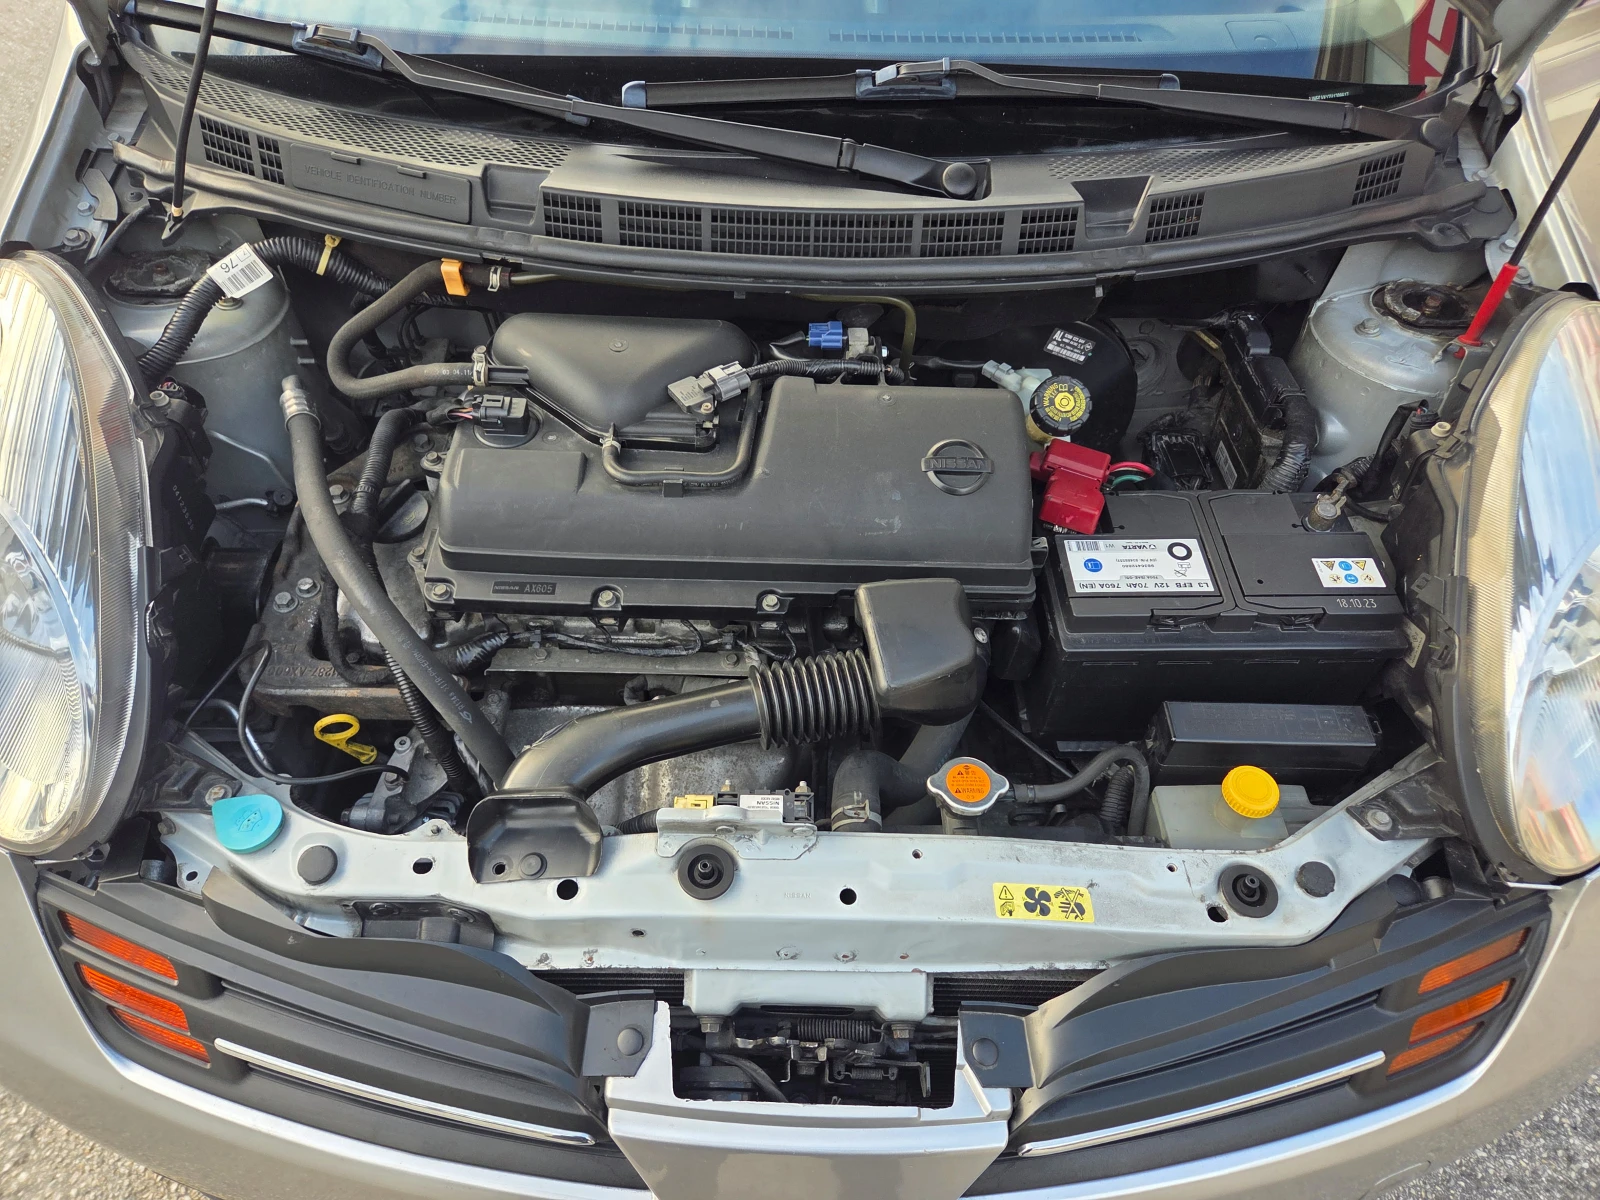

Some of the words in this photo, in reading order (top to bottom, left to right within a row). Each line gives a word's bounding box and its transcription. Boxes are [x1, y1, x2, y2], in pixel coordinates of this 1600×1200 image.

[304, 164, 341, 184] VEHICLE
[346, 173, 415, 197] IDENTIFICATION
[420, 188, 457, 206] NUMBER
[220, 258, 239, 274] 76
[1043, 382, 1059, 407] WARNING
[930, 458, 987, 470] NISSAN
[524, 583, 553, 594] AX605
[1079, 582, 1096, 590] (EN)
[1336, 598, 1377, 609] 18.10.23
